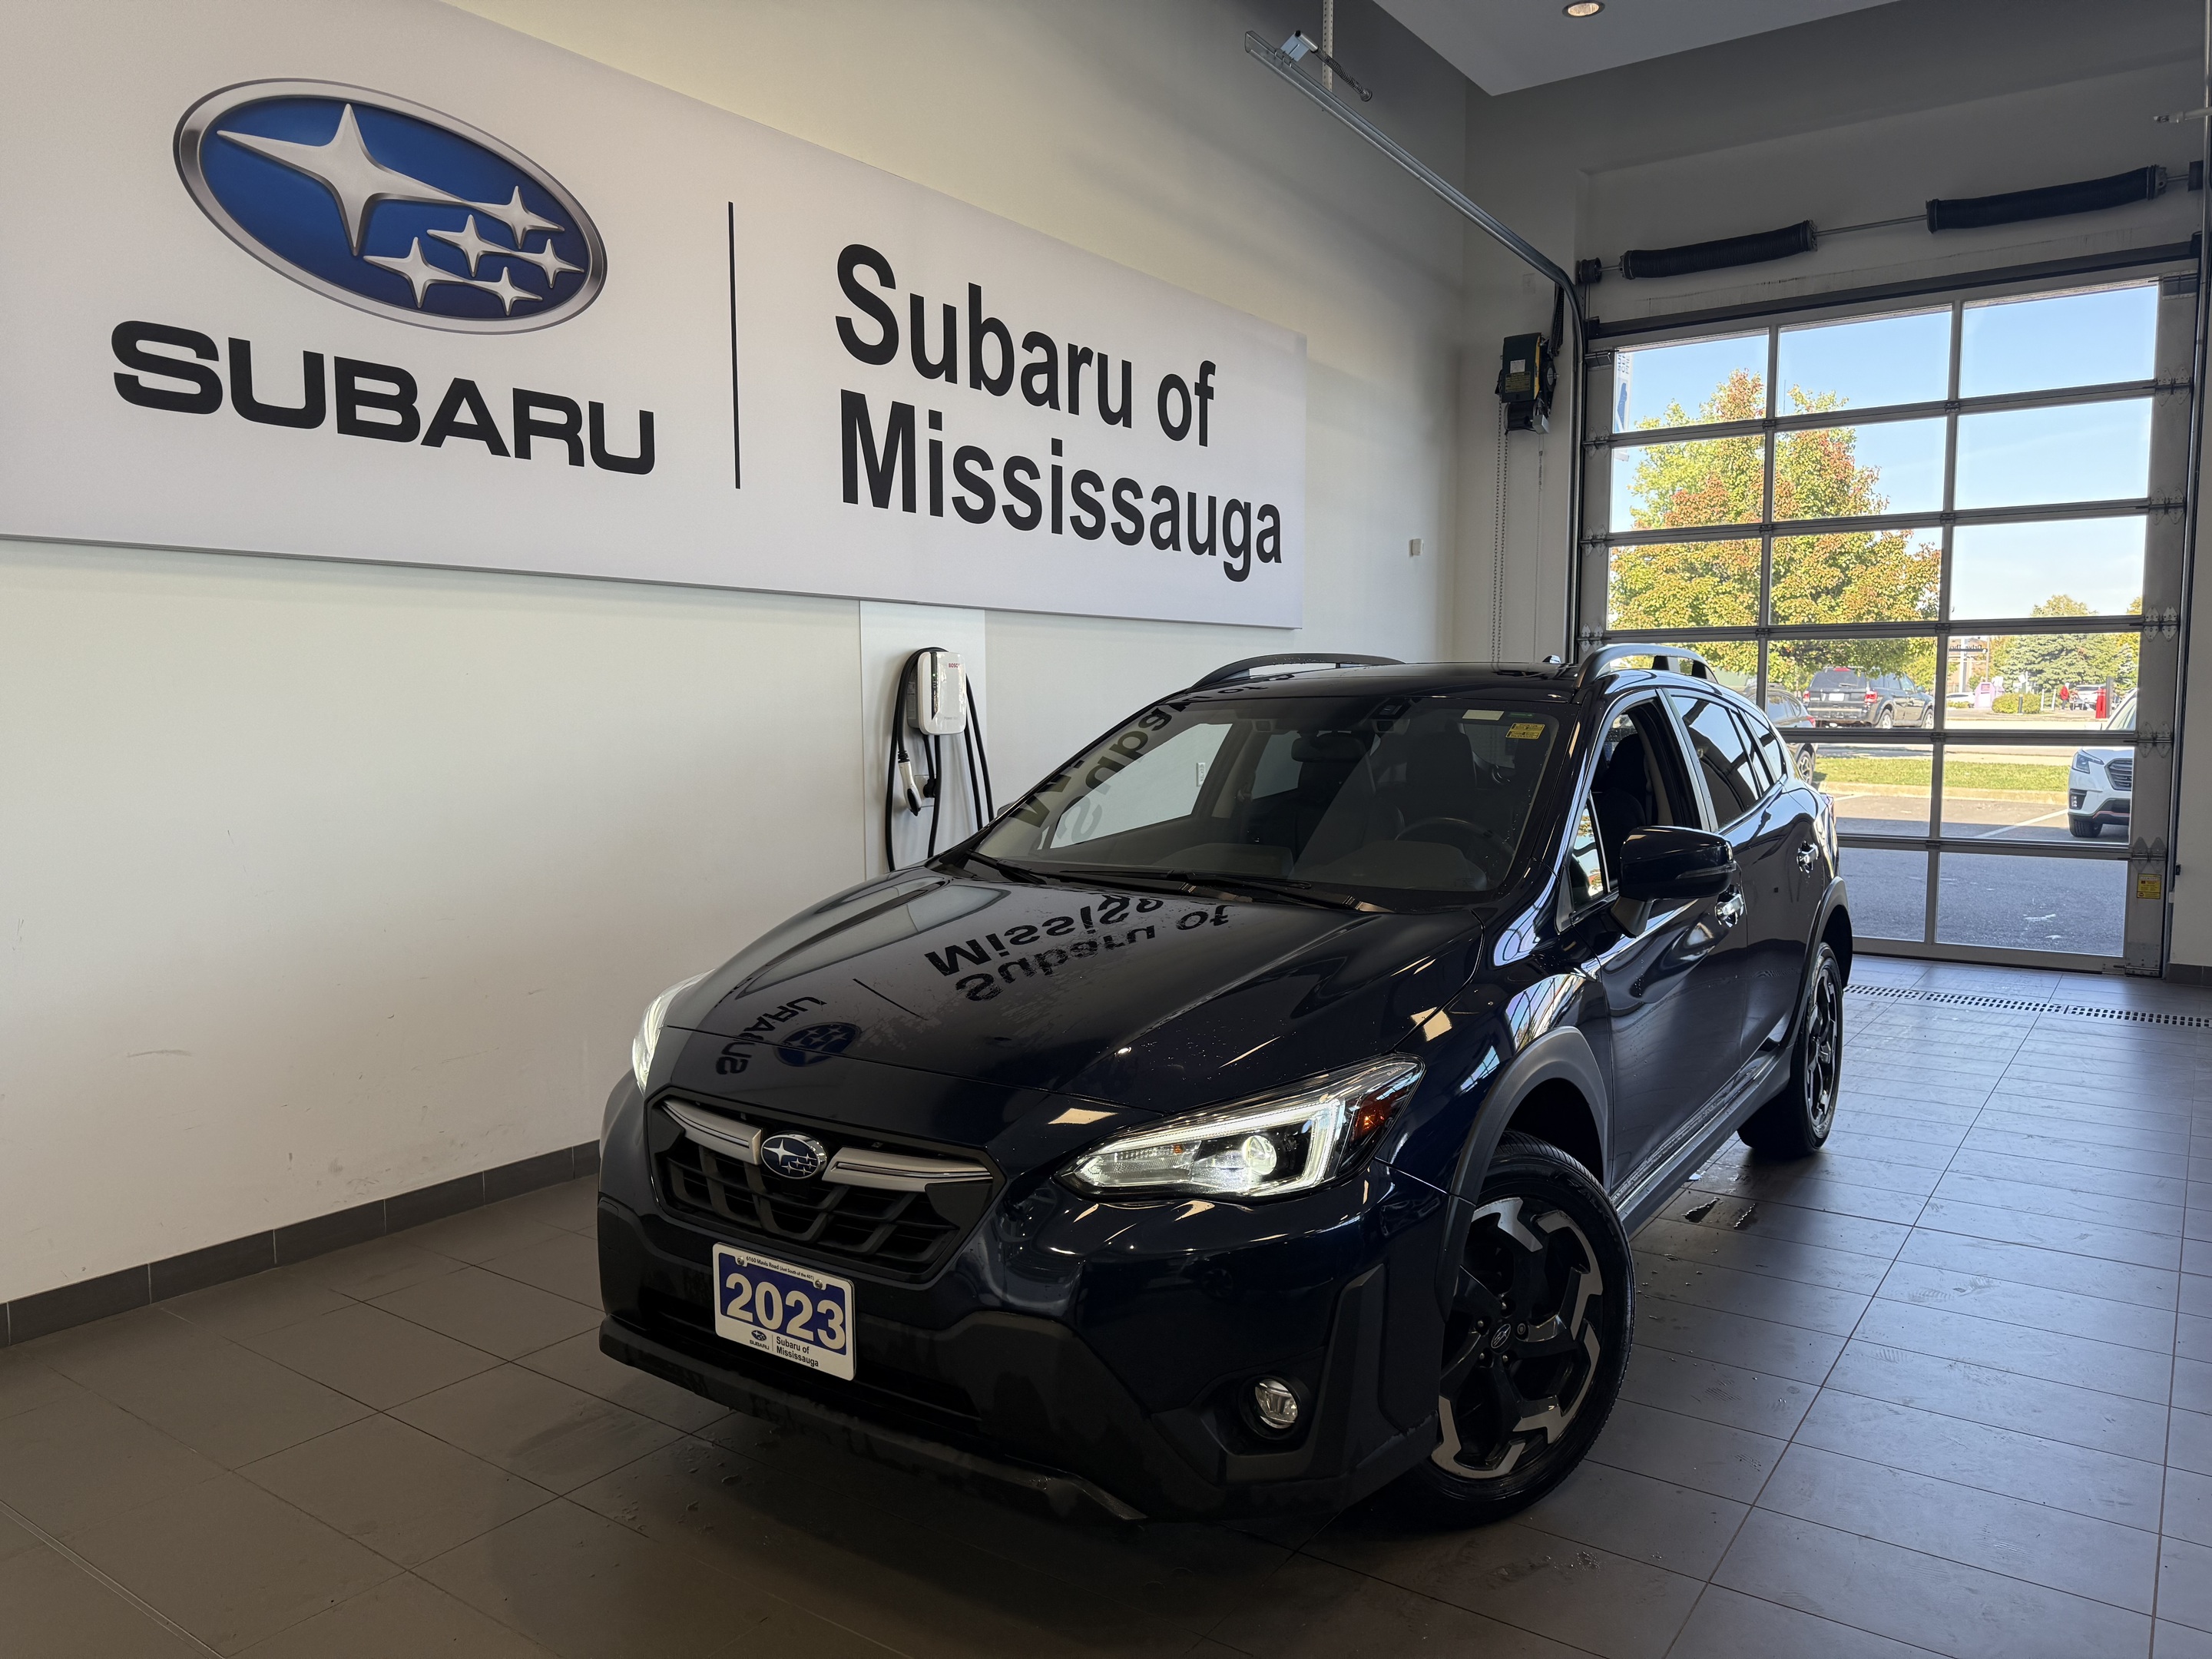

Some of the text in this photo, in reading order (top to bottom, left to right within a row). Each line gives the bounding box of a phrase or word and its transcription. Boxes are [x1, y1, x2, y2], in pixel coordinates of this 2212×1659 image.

[835, 243, 1217, 448] Subaru of
[111, 320, 655, 475] SUBARU
[840, 389, 1283, 583] Mississauga
[769, 1261, 780, 1270] Road
[726, 1273, 846, 1349] 2023
[750, 1339, 770, 1350] SUBARU
[776, 1336, 810, 1354] Subaru of
[776, 1345, 820, 1367] Mississauga
